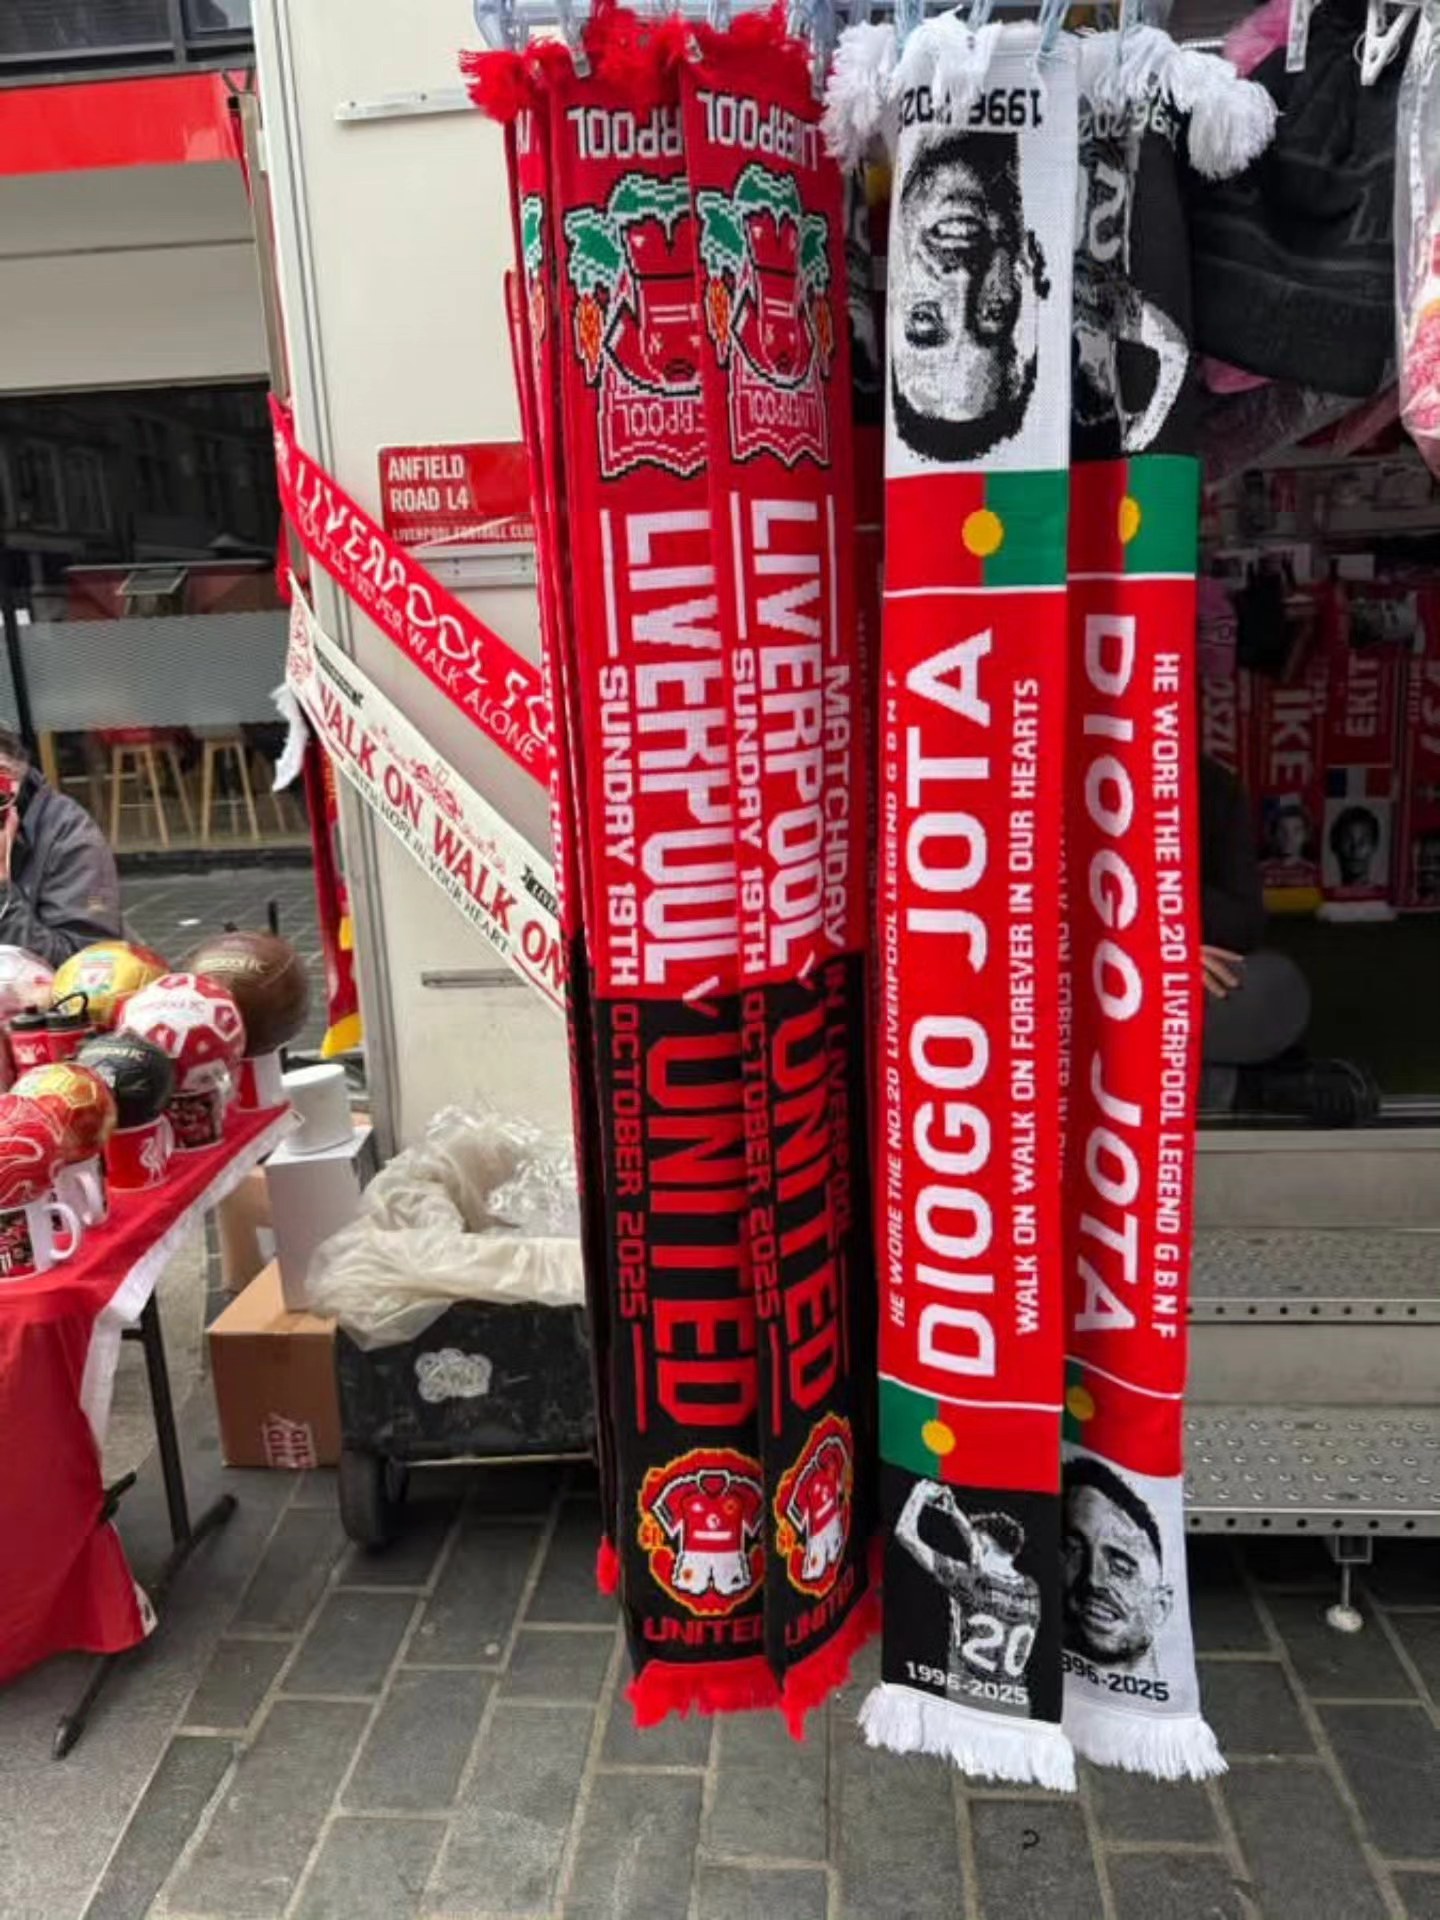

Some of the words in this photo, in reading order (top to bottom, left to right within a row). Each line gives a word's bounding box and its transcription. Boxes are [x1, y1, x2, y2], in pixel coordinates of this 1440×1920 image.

[388, 454, 464, 481] ANFIELD
[391, 488, 440, 512] ROAD
[447, 486, 470, 511] L4
[296, 460, 489, 685] LIVERPOOL
[406, 622, 464, 694] WALK
[463, 687, 541, 764] ALONE
[1153, 652, 1181, 693] HE
[599, 664, 636, 867] SUNDAY
[731, 649, 763, 850] SUNDAY
[750, 498, 823, 968] LIVERPOOL
[1010, 677, 1039, 801] HEARTS
[1151, 701, 1179, 802] WORE
[383, 764, 424, 830] ON
[432, 813, 519, 937] WALK
[824, 664, 851, 946] MATCHDAY
[883, 793, 898, 902] LEGEND
[905, 626, 993, 974] JOTA
[1007, 808, 1034, 873] OUR
[1083, 612, 1143, 1021] DIOGO
[1154, 805, 1182, 863] THE
[429, 859, 463, 901] YOUR
[464, 899, 510, 954] HEART
[606, 881, 639, 987] 19TH
[740, 867, 766, 975] 19TH
[1008, 881, 1034, 914] IN
[1156, 869, 1189, 963] NO.20
[884, 908, 900, 1060] LIVERPOOL
[1008, 924, 1035, 1047] FOREVER
[611, 1003, 645, 1197] OCTOBER
[741, 991, 772, 1194] OCTOBER
[1011, 1058, 1035, 1101] ON
[1160, 971, 1190, 1126] LIVERPOOL
[885, 1069, 902, 1150] NO.20
[1011, 1110, 1037, 1195] WALK
[646, 1031, 757, 1428] UNITED
[772, 1006, 839, 1411] UNITED
[887, 1152, 903, 1205] THE
[909, 1014, 997, 1378] DIOGO
[1012, 1204, 1037, 1247] ON
[1074, 1048, 1143, 1333] JOTA
[1155, 1132, 1184, 1236] LEGEND
[616, 1210, 647, 1320] 2025
[749, 1204, 782, 1321] 2025
[887, 1209, 904, 1295] WORE
[1013, 1253, 1040, 1336] WALK
[888, 1296, 905, 1327] HE
[905, 1660, 1030, 1706] 1996-2025
[960, 1613, 1036, 1678] 20
[1060, 1651, 1170, 1703] 996-2025
